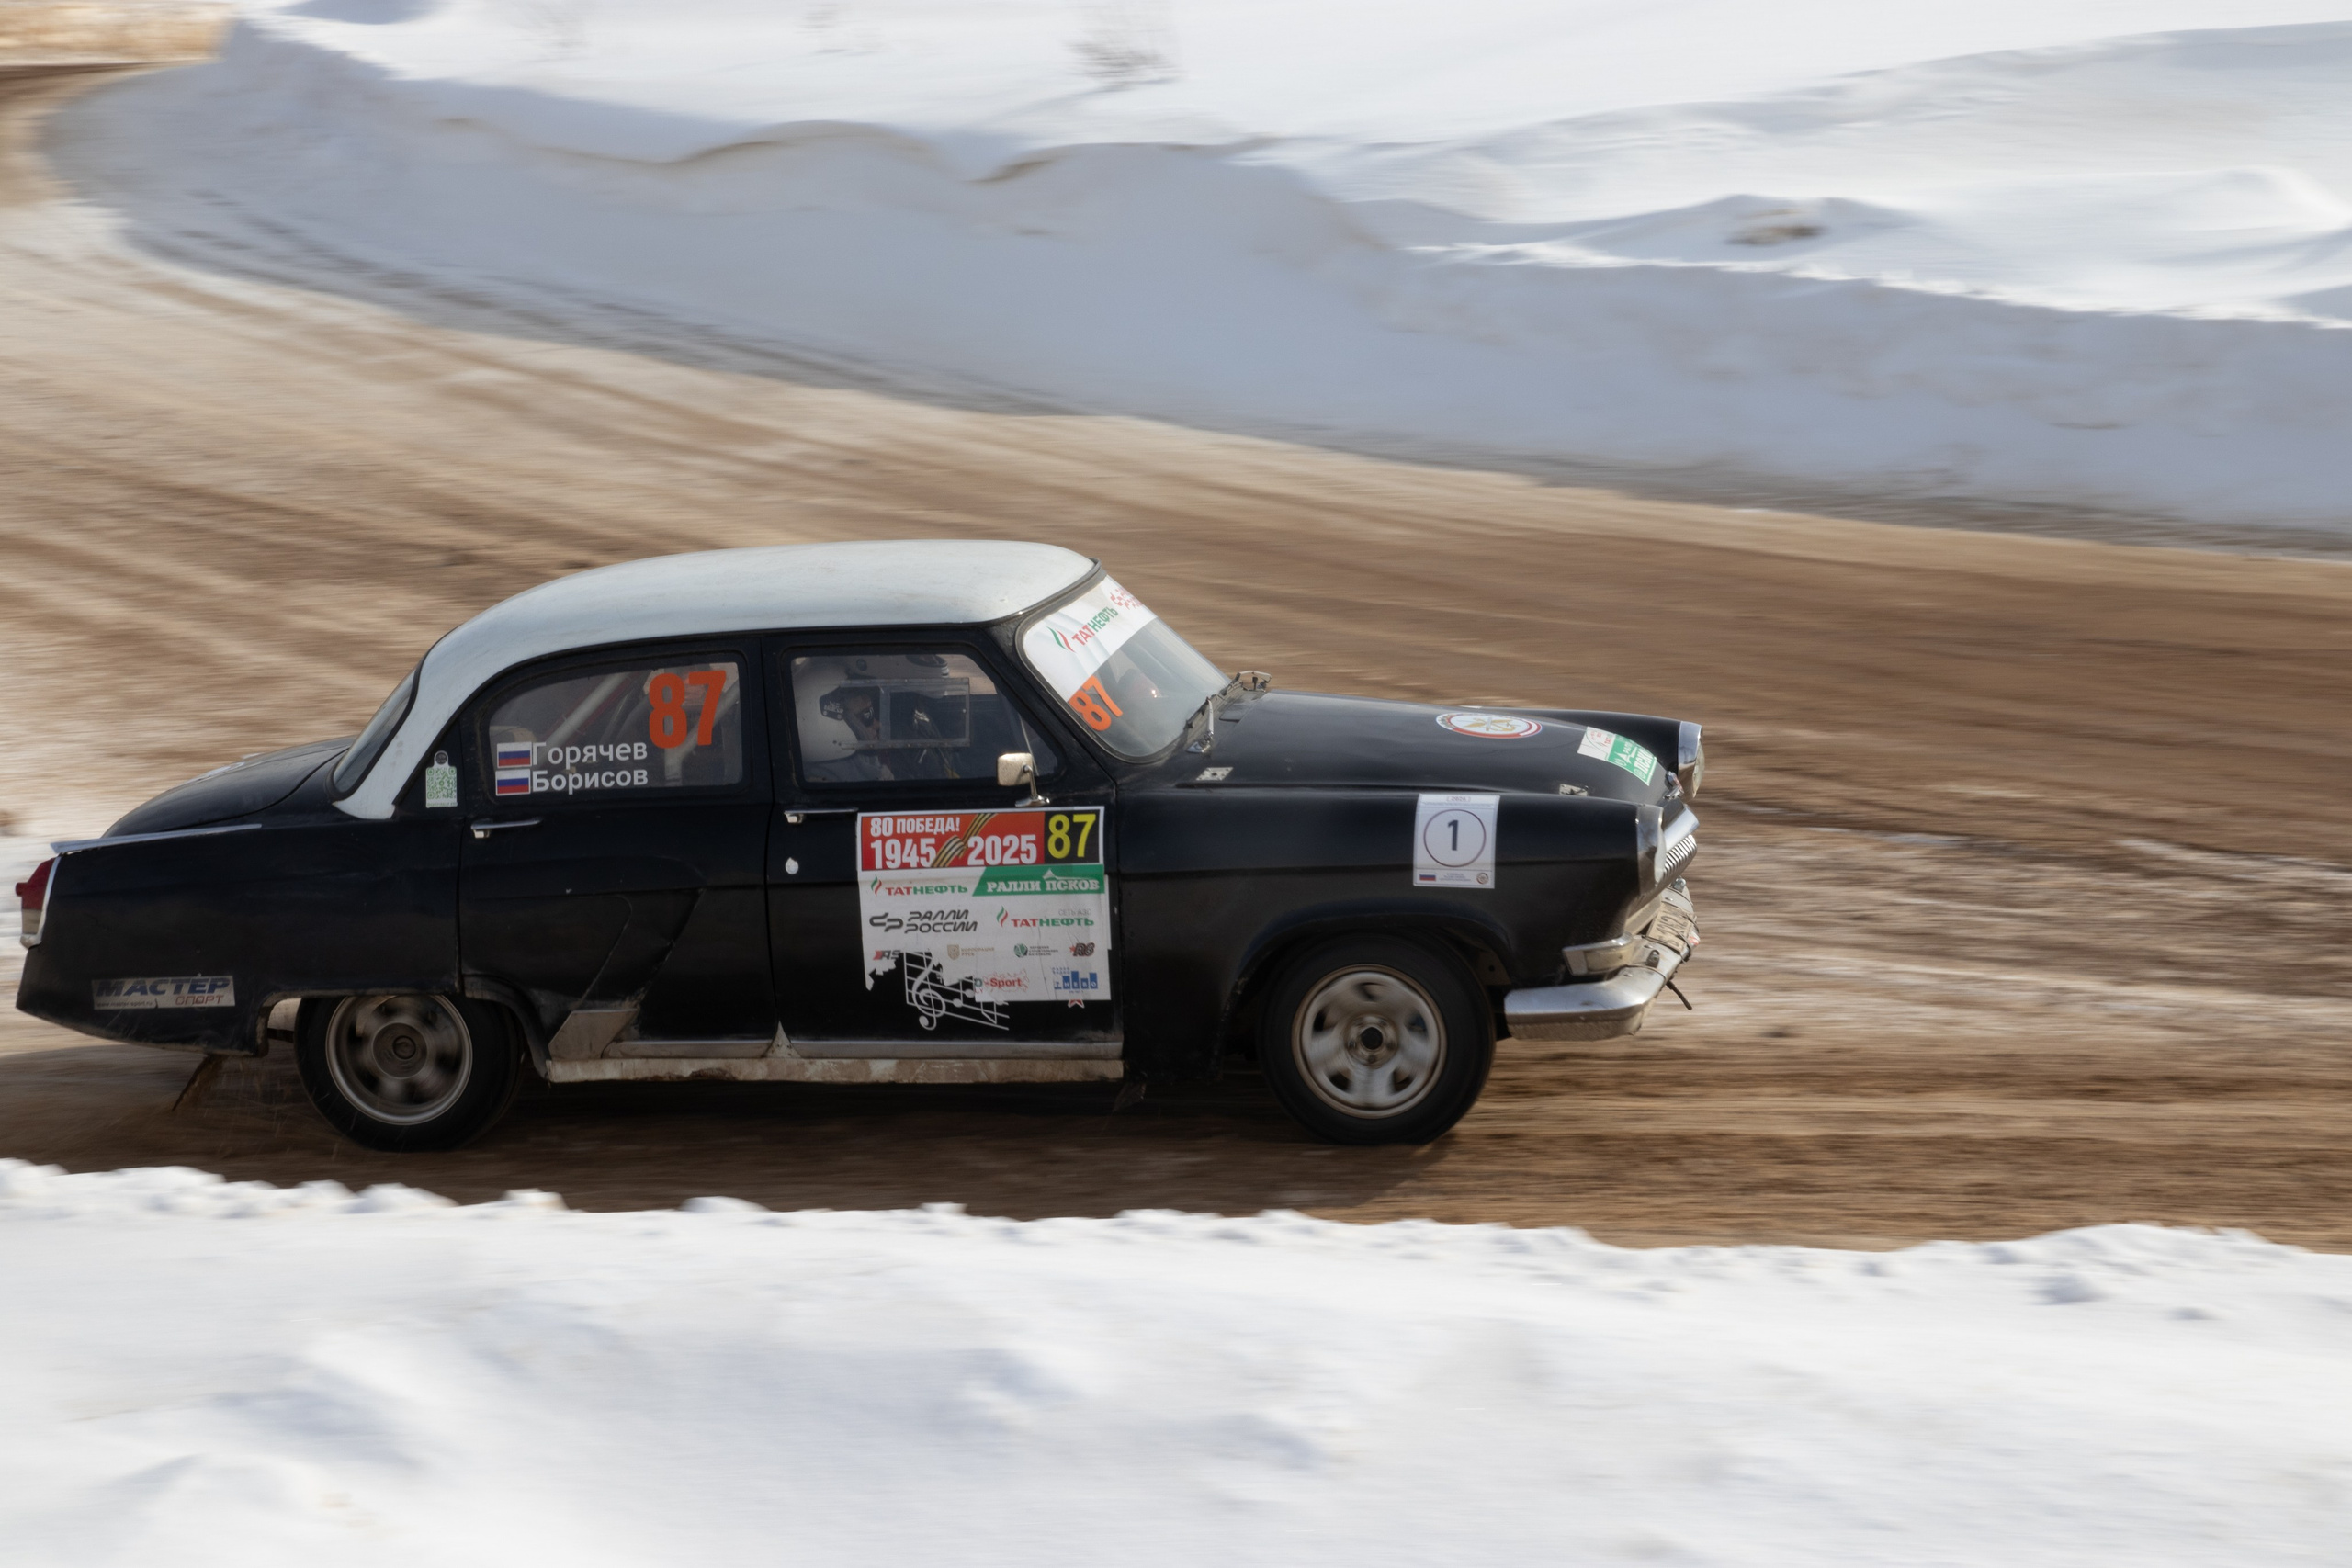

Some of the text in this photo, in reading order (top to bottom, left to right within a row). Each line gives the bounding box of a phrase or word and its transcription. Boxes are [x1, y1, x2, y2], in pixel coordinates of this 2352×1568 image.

[1071, 606, 1119, 645] ТАТНЕФТЬ
[649, 670, 727, 749] 87
[1068, 674, 1124, 731] 87
[532, 741, 649, 769] Горячев
[531, 769, 649, 795] Борисов
[870, 817, 961, 837] 80 ПОБЕДА!
[1047, 813, 1097, 859] 87
[1447, 819, 1458, 851] 1
[870, 834, 1037, 869] 1945 2025
[885, 884, 968, 896] ТАТНЕФТЬ
[986, 878, 1100, 893] РАЛЛИ ПСКОВ
[908, 909, 969, 921] РАЛЛИ
[1011, 918, 1094, 928] ТАТНЕФТЬ
[904, 921, 978, 933] РОССИИ
[96, 977, 229, 997] МАСТЕР
[175, 994, 224, 1006] СПОРТ
